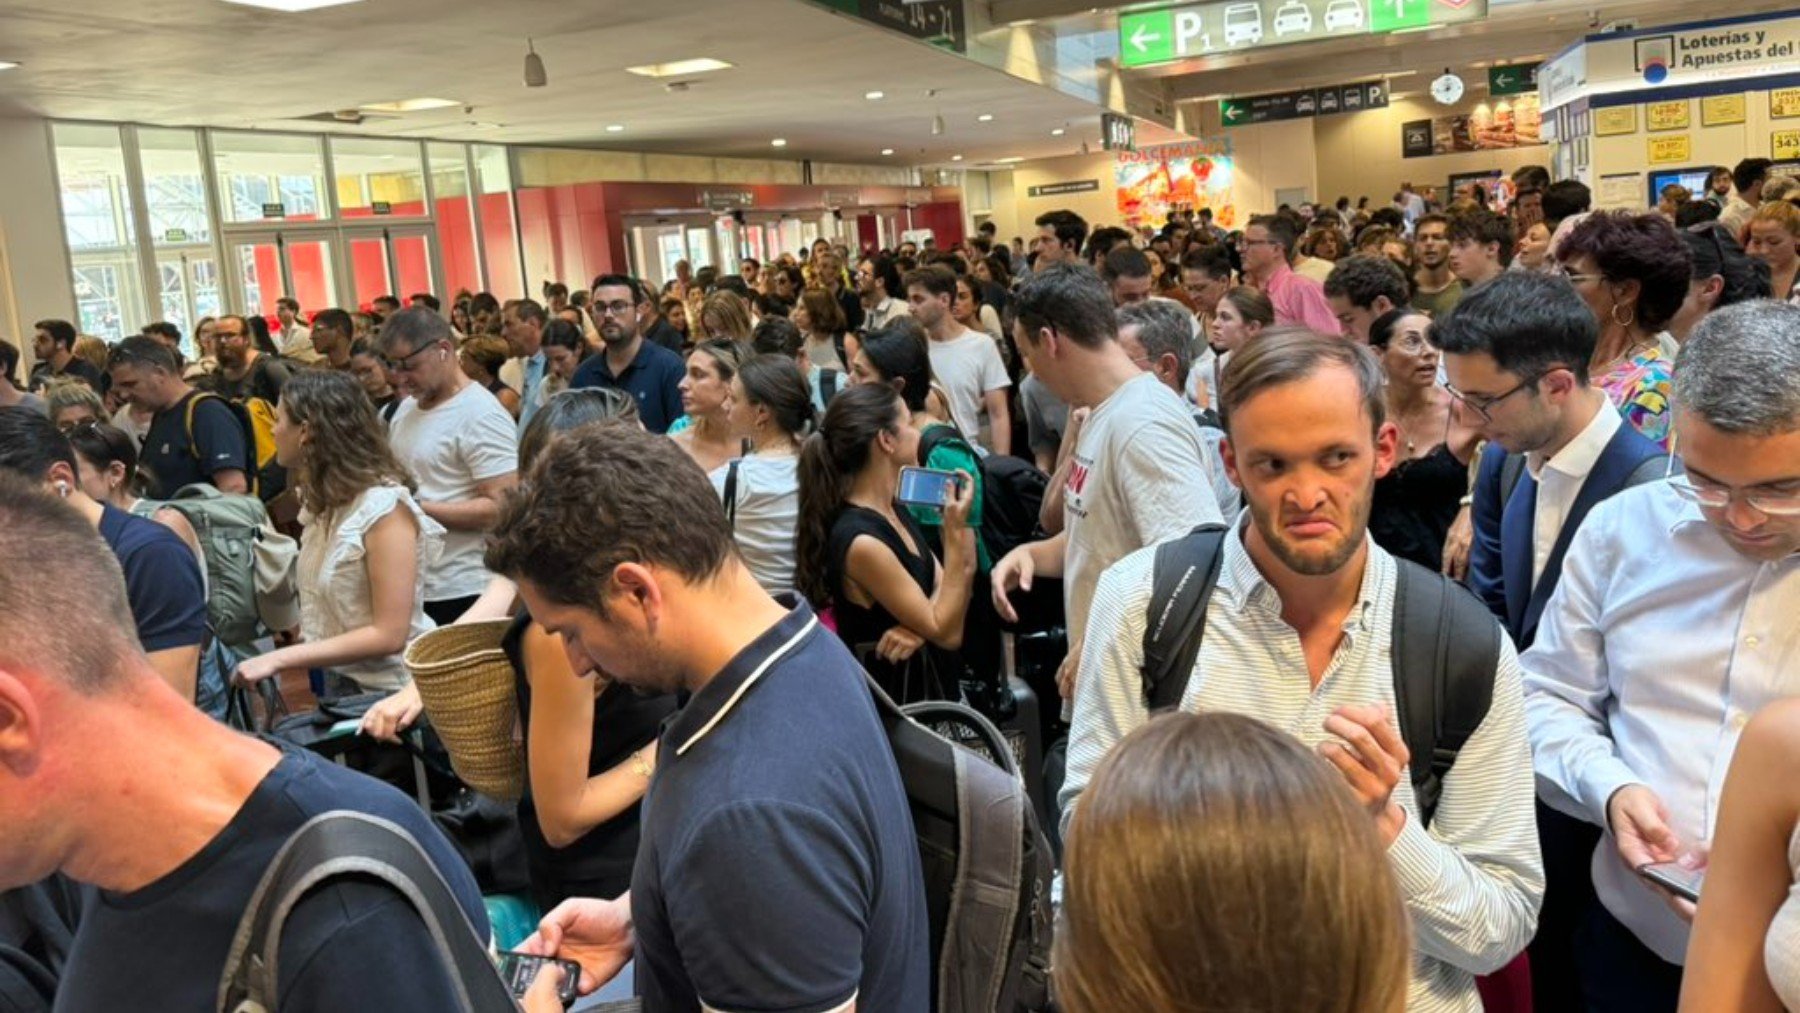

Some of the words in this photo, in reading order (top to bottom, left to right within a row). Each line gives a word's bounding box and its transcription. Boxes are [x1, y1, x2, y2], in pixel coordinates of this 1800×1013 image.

[1755, 30, 1766, 44] y
[1681, 46, 1761, 69] Apuestas
[1767, 40, 1793, 58] del
